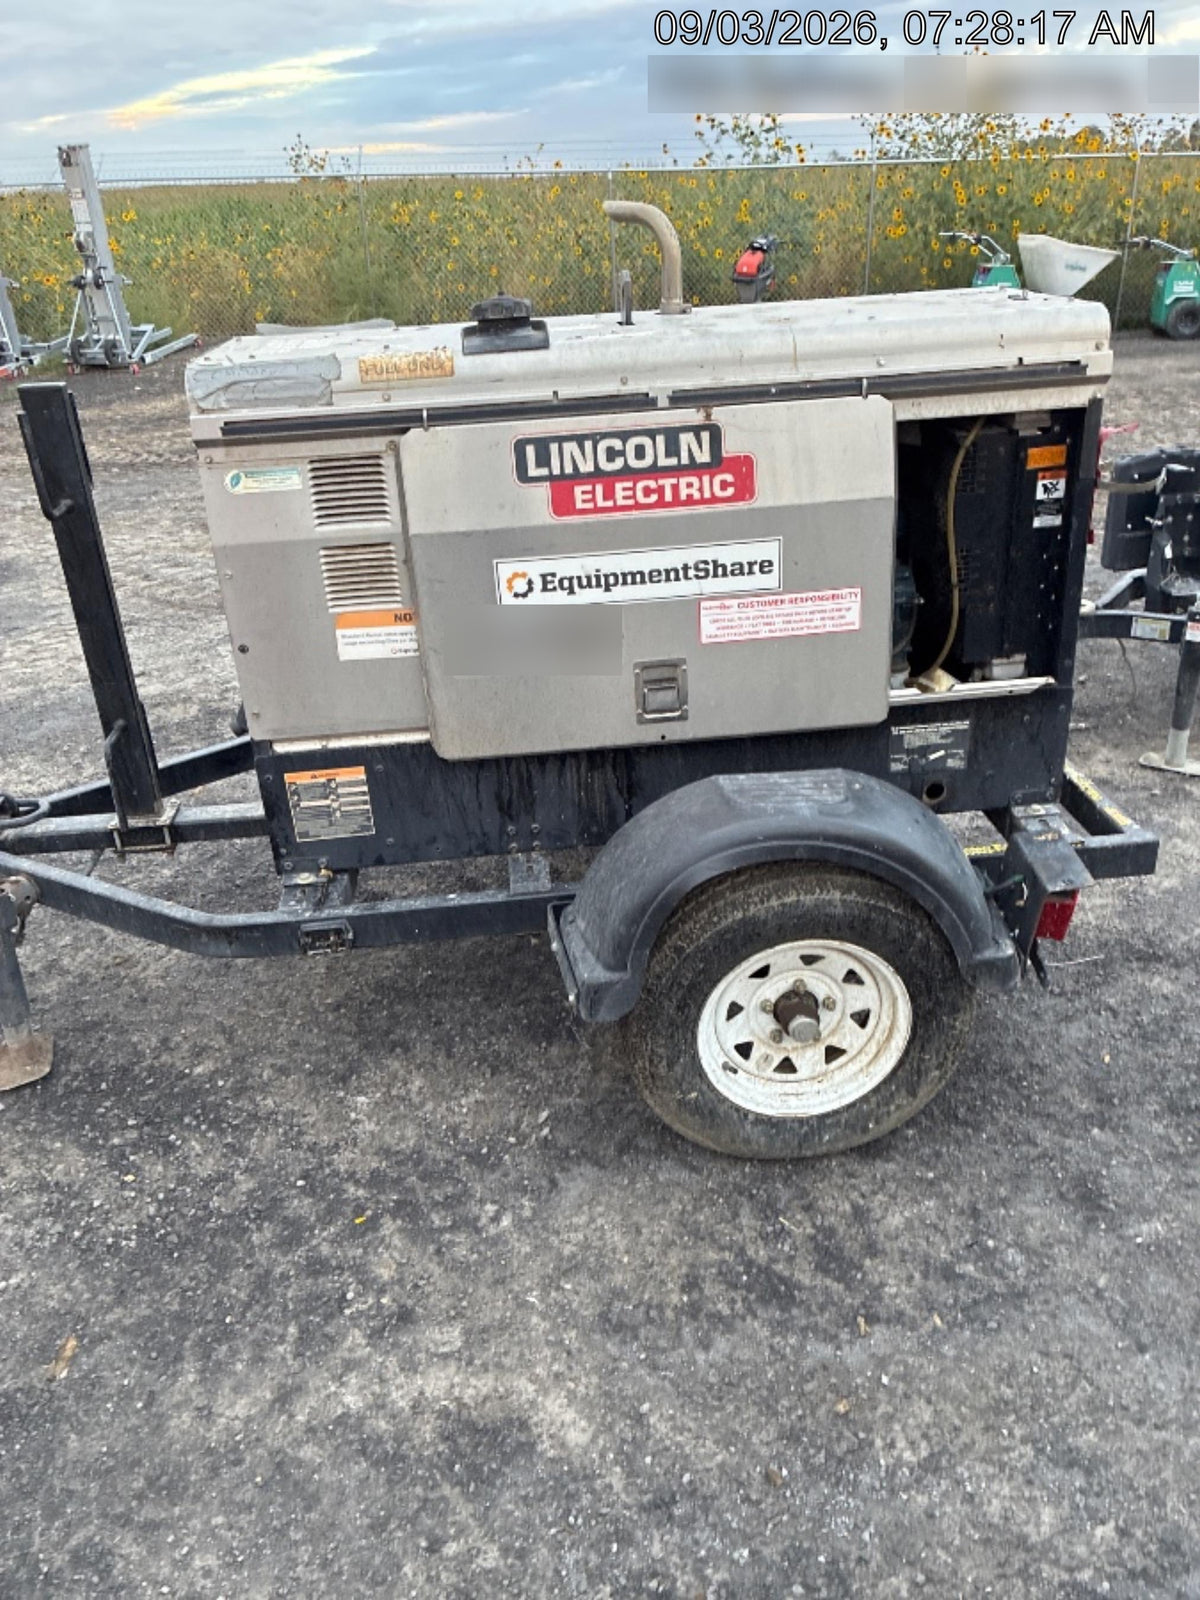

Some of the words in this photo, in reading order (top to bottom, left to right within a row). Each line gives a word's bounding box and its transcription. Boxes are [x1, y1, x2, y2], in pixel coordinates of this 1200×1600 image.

[525, 430, 712, 478] LINCOLN
[573, 473, 736, 510] ELECTRIC
[540, 558, 774, 595] EquipmentShare
[737, 599, 785, 609] CUSTOMER
[788, 591, 859, 605] RESPONSIBILITY
